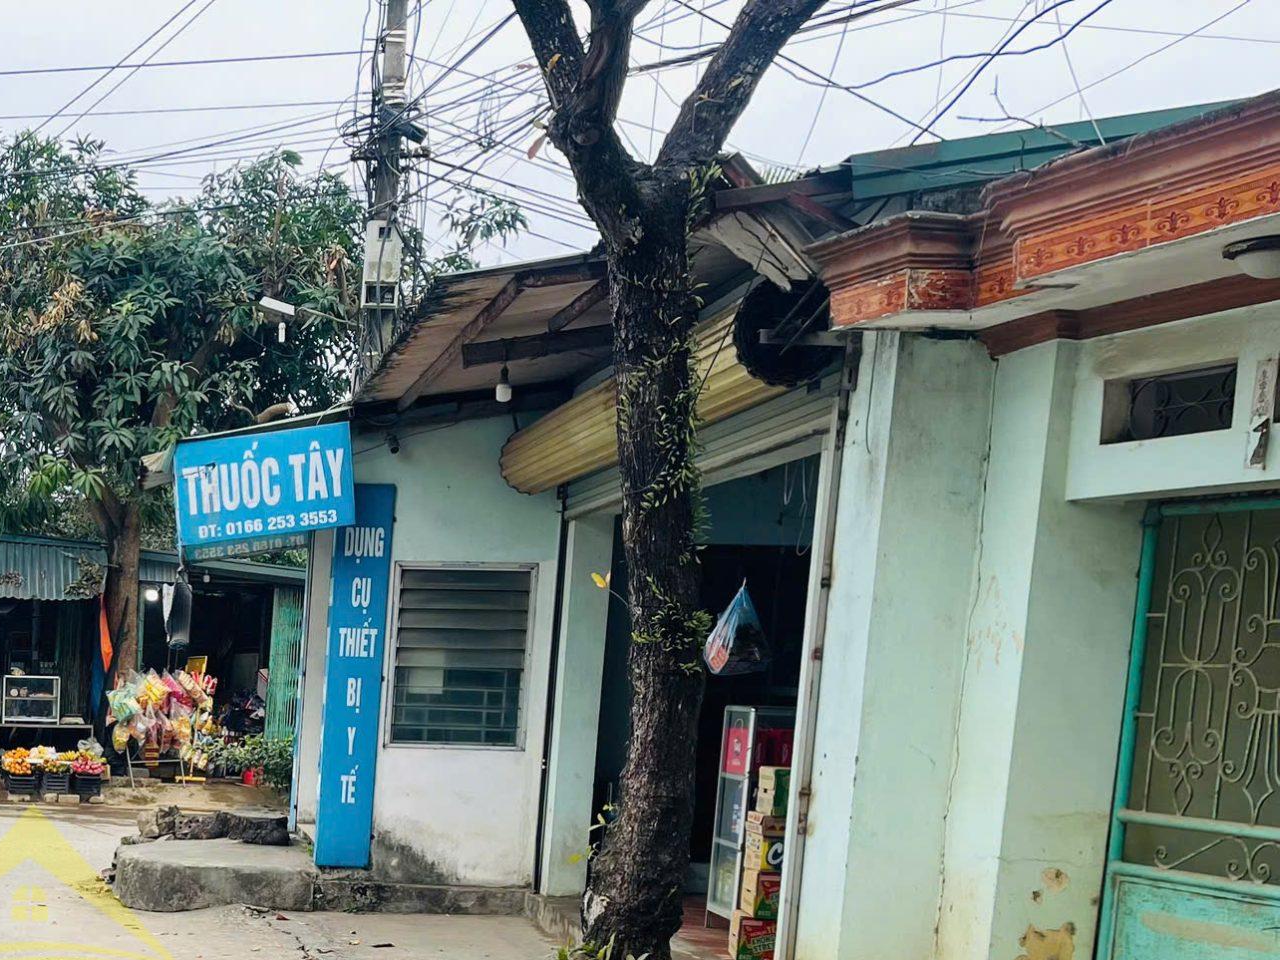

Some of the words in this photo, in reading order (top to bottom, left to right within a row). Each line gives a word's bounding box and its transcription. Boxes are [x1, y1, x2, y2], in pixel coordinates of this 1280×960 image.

[182, 441, 281, 516] THUỐC
[288, 440, 344, 502] TÂY
[198, 524, 222, 539] ĐT:
[225, 518, 263, 536] 0166
[267, 513, 296, 530] 253
[300, 509, 338, 526] 3553
[344, 526, 385, 564] DỤNG
[351, 577, 372, 614] CỤ
[338, 617, 378, 658] THIẾT
[346, 677, 362, 714] BỊ
[347, 726, 356, 756] Y
[340, 764, 359, 804] TẾ
